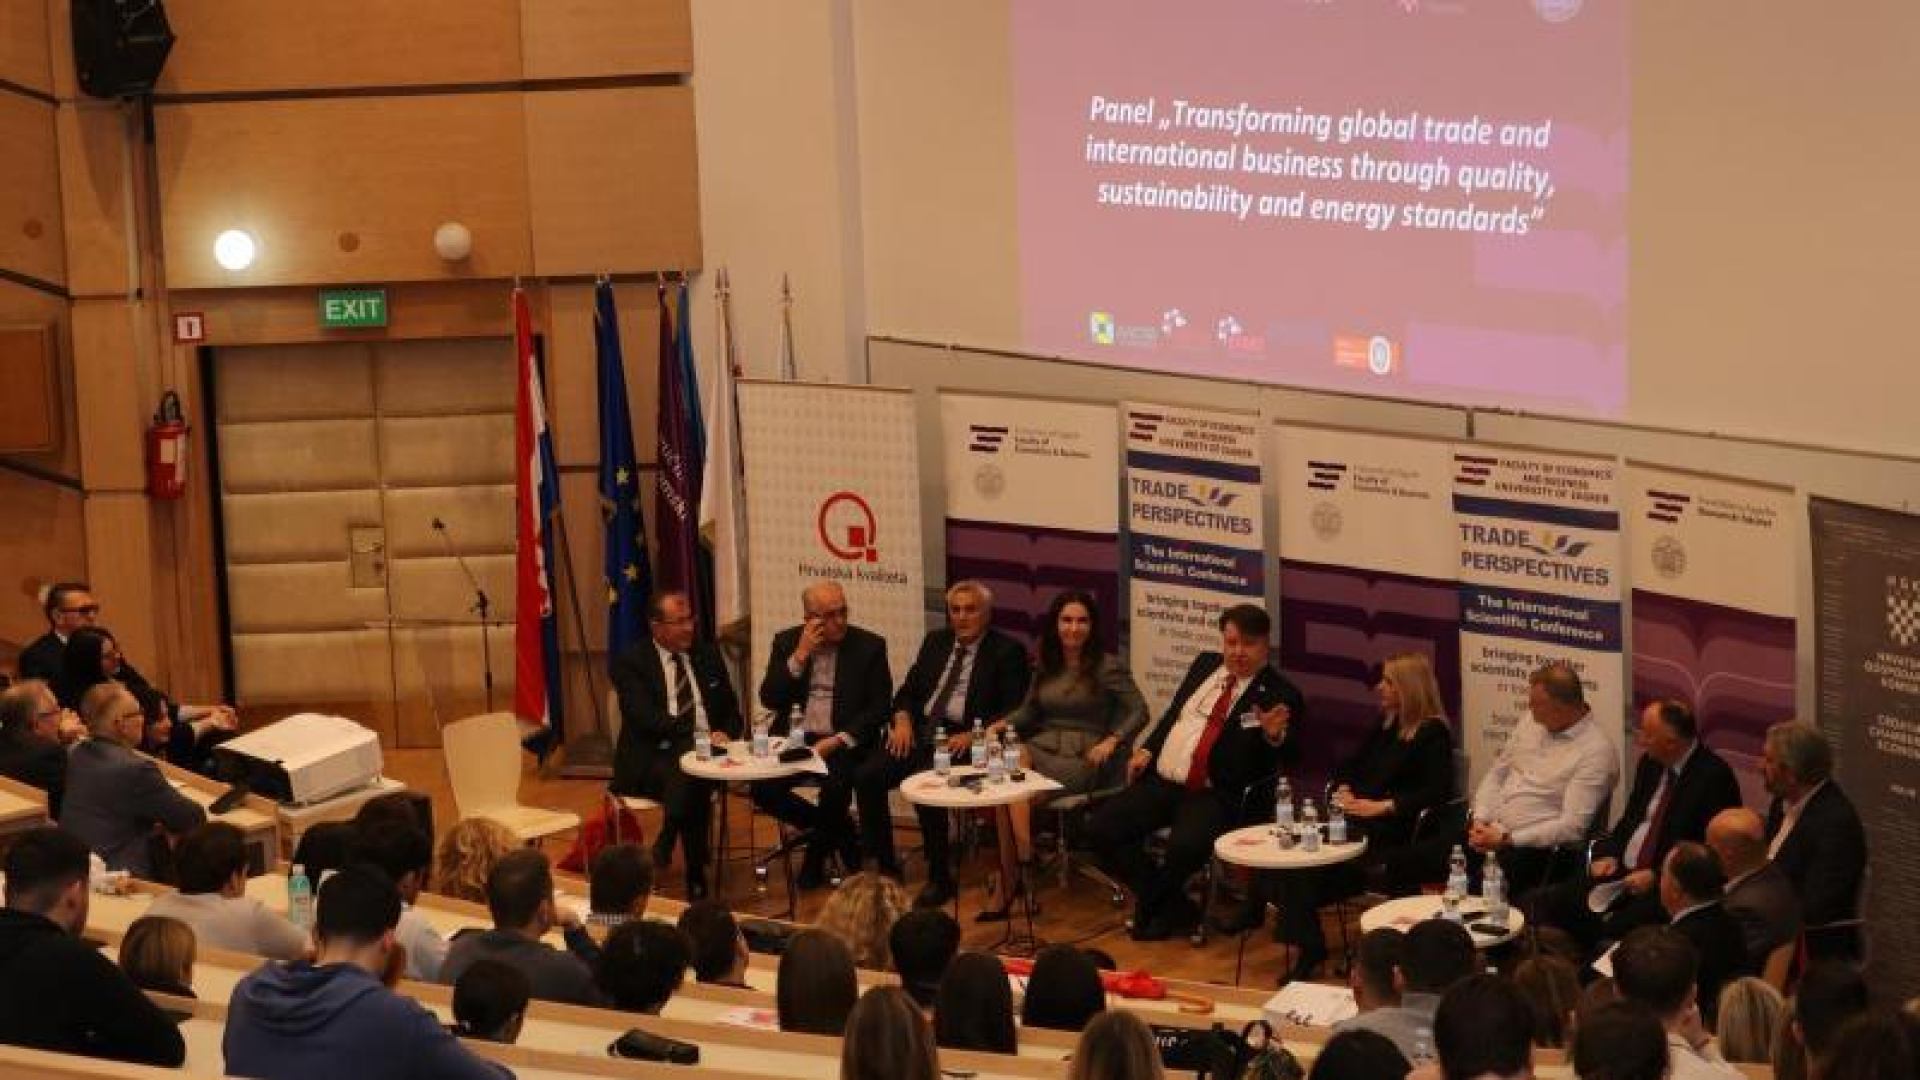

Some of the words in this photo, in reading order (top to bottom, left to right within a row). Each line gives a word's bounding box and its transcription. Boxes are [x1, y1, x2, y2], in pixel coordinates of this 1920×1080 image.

[1090, 95, 1154, 124] Panel
[1339, 108, 1418, 145] global
[1424, 115, 1493, 145] trade
[1500, 119, 1551, 148] and
[1085, 134, 1237, 169] international
[1242, 144, 1344, 179] business
[1351, 151, 1450, 192] through
[1458, 160, 1556, 199] quality,
[1097, 179, 1252, 221] sustainability
[1259, 191, 1306, 217] and
[1311, 198, 1396, 231] energy
[325, 298, 381, 320] EXIT
[1131, 477, 1189, 499] TRADE
[1132, 503, 1253, 535] PERSPECTIVES
[1459, 521, 1530, 547] TRADE
[1143, 543, 1165, 558] The
[1168, 546, 1237, 568] International
[1461, 550, 1609, 586] PERSPECTIVES
[798, 562, 853, 581] Hrvatska
[1134, 557, 1185, 576] Scientific
[1187, 565, 1249, 586] Conference
[1477, 593, 1503, 609] The
[1506, 597, 1590, 621] International
[1464, 609, 1528, 630] Scientific
[1530, 619, 1604, 642] Conference
[1470, 661, 1527, 680] scientists
[1482, 647, 1532, 666] bringing
